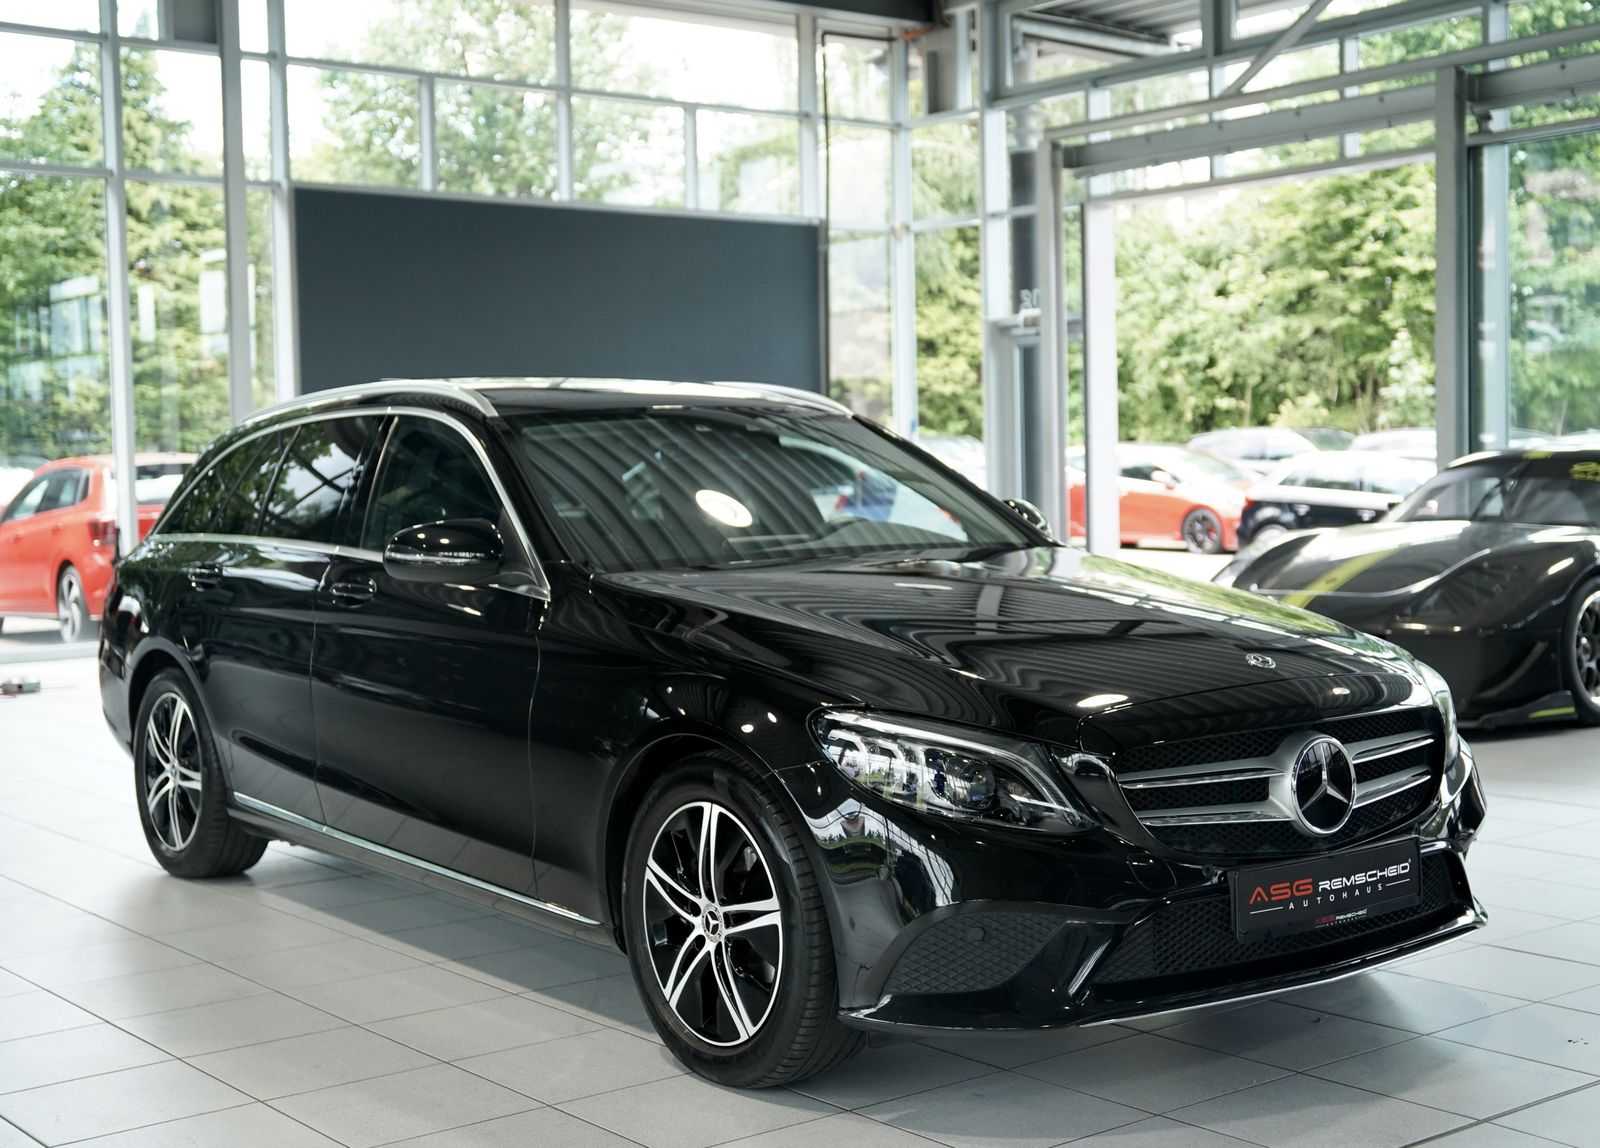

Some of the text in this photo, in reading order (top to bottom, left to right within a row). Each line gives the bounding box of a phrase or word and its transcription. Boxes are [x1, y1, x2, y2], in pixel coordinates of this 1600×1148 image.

[1249, 862, 1410, 904] ASG REMSCHEID
[1289, 883, 1382, 910] AUTOHAUS
